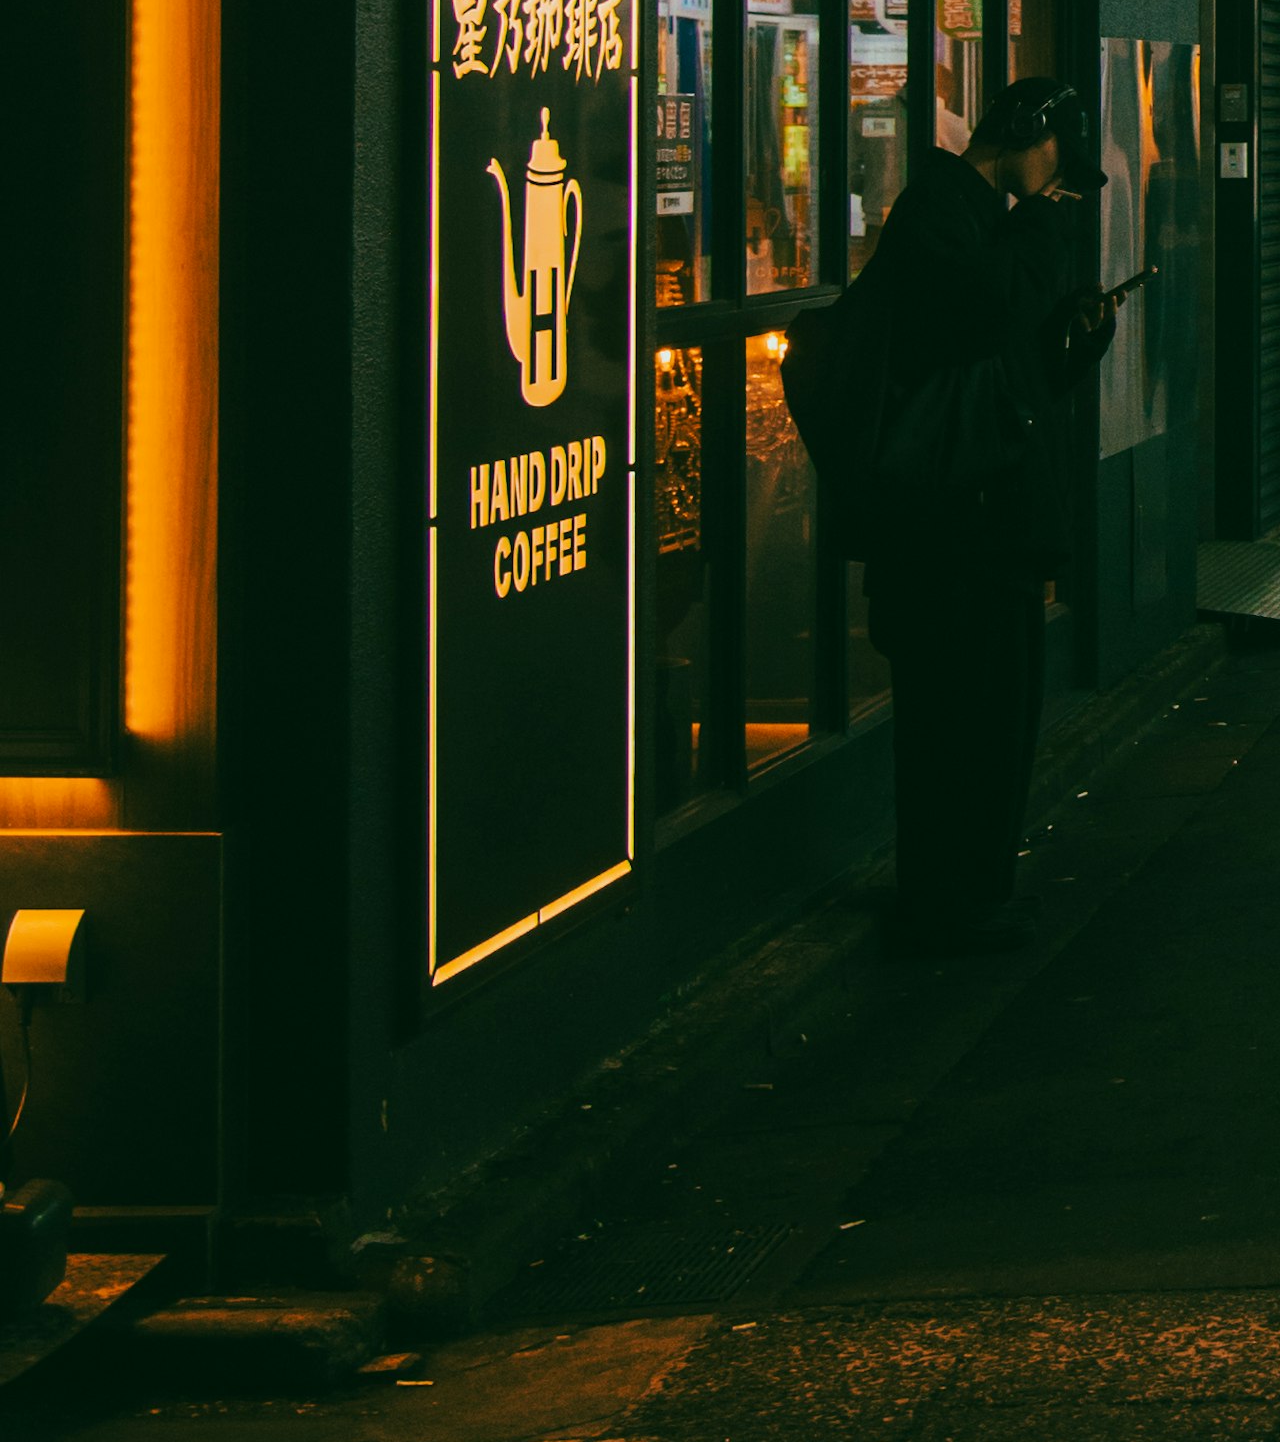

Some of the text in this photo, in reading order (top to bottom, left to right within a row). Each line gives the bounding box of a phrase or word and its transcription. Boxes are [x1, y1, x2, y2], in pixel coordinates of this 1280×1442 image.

[469, 435, 607, 530] HAND DRIP
[493, 512, 588, 599] COFFEE
